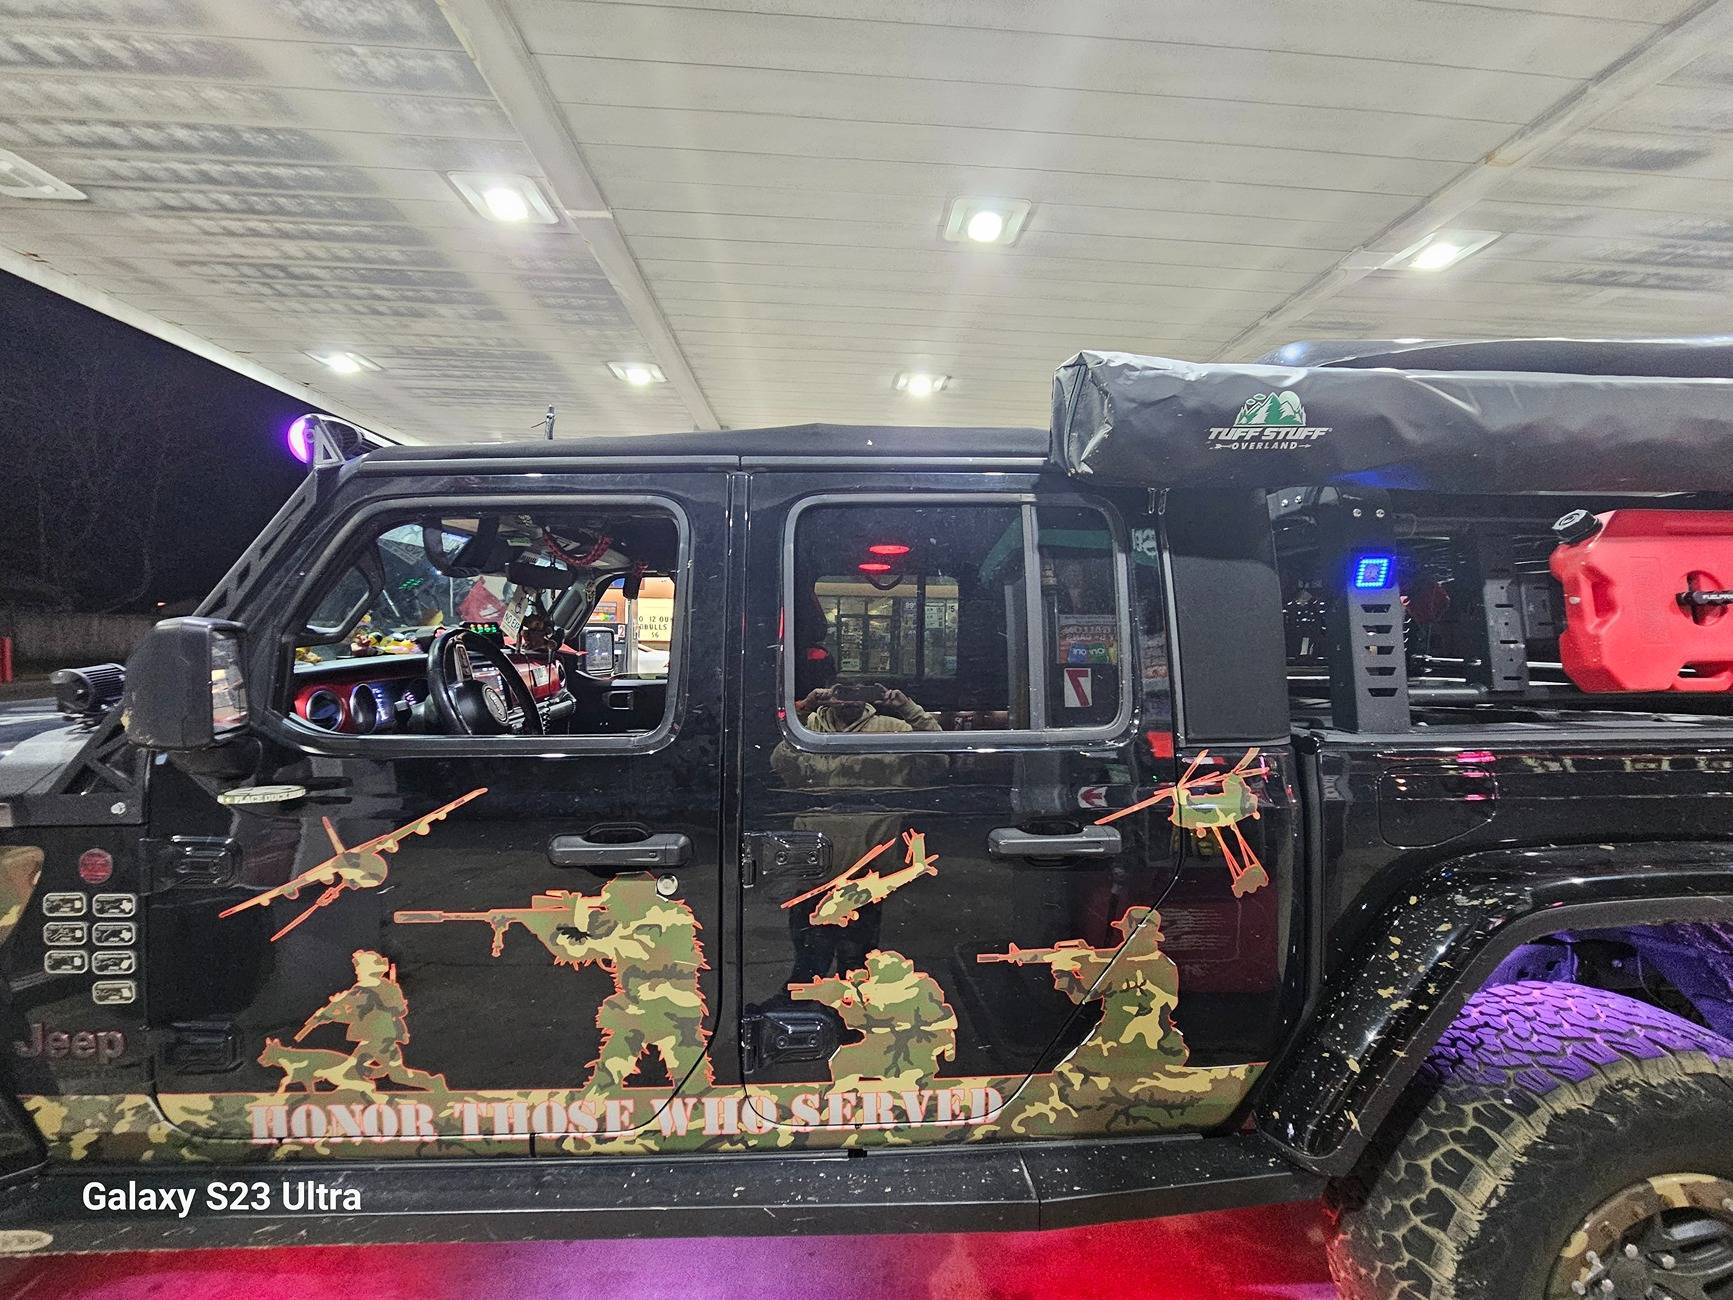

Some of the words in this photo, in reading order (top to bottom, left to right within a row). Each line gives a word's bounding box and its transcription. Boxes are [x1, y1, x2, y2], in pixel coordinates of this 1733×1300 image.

[1208, 427, 1263, 440] TUFF
[1261, 427, 1329, 440] STUFF
[1231, 441, 1299, 451] OVERLAND
[14, 1023, 127, 1064] Jeep
[250, 1103, 437, 1144] HONOR
[452, 1099, 635, 1141] THOSE
[651, 1095, 779, 1137] WHO
[790, 1087, 1004, 1133] SERVED
